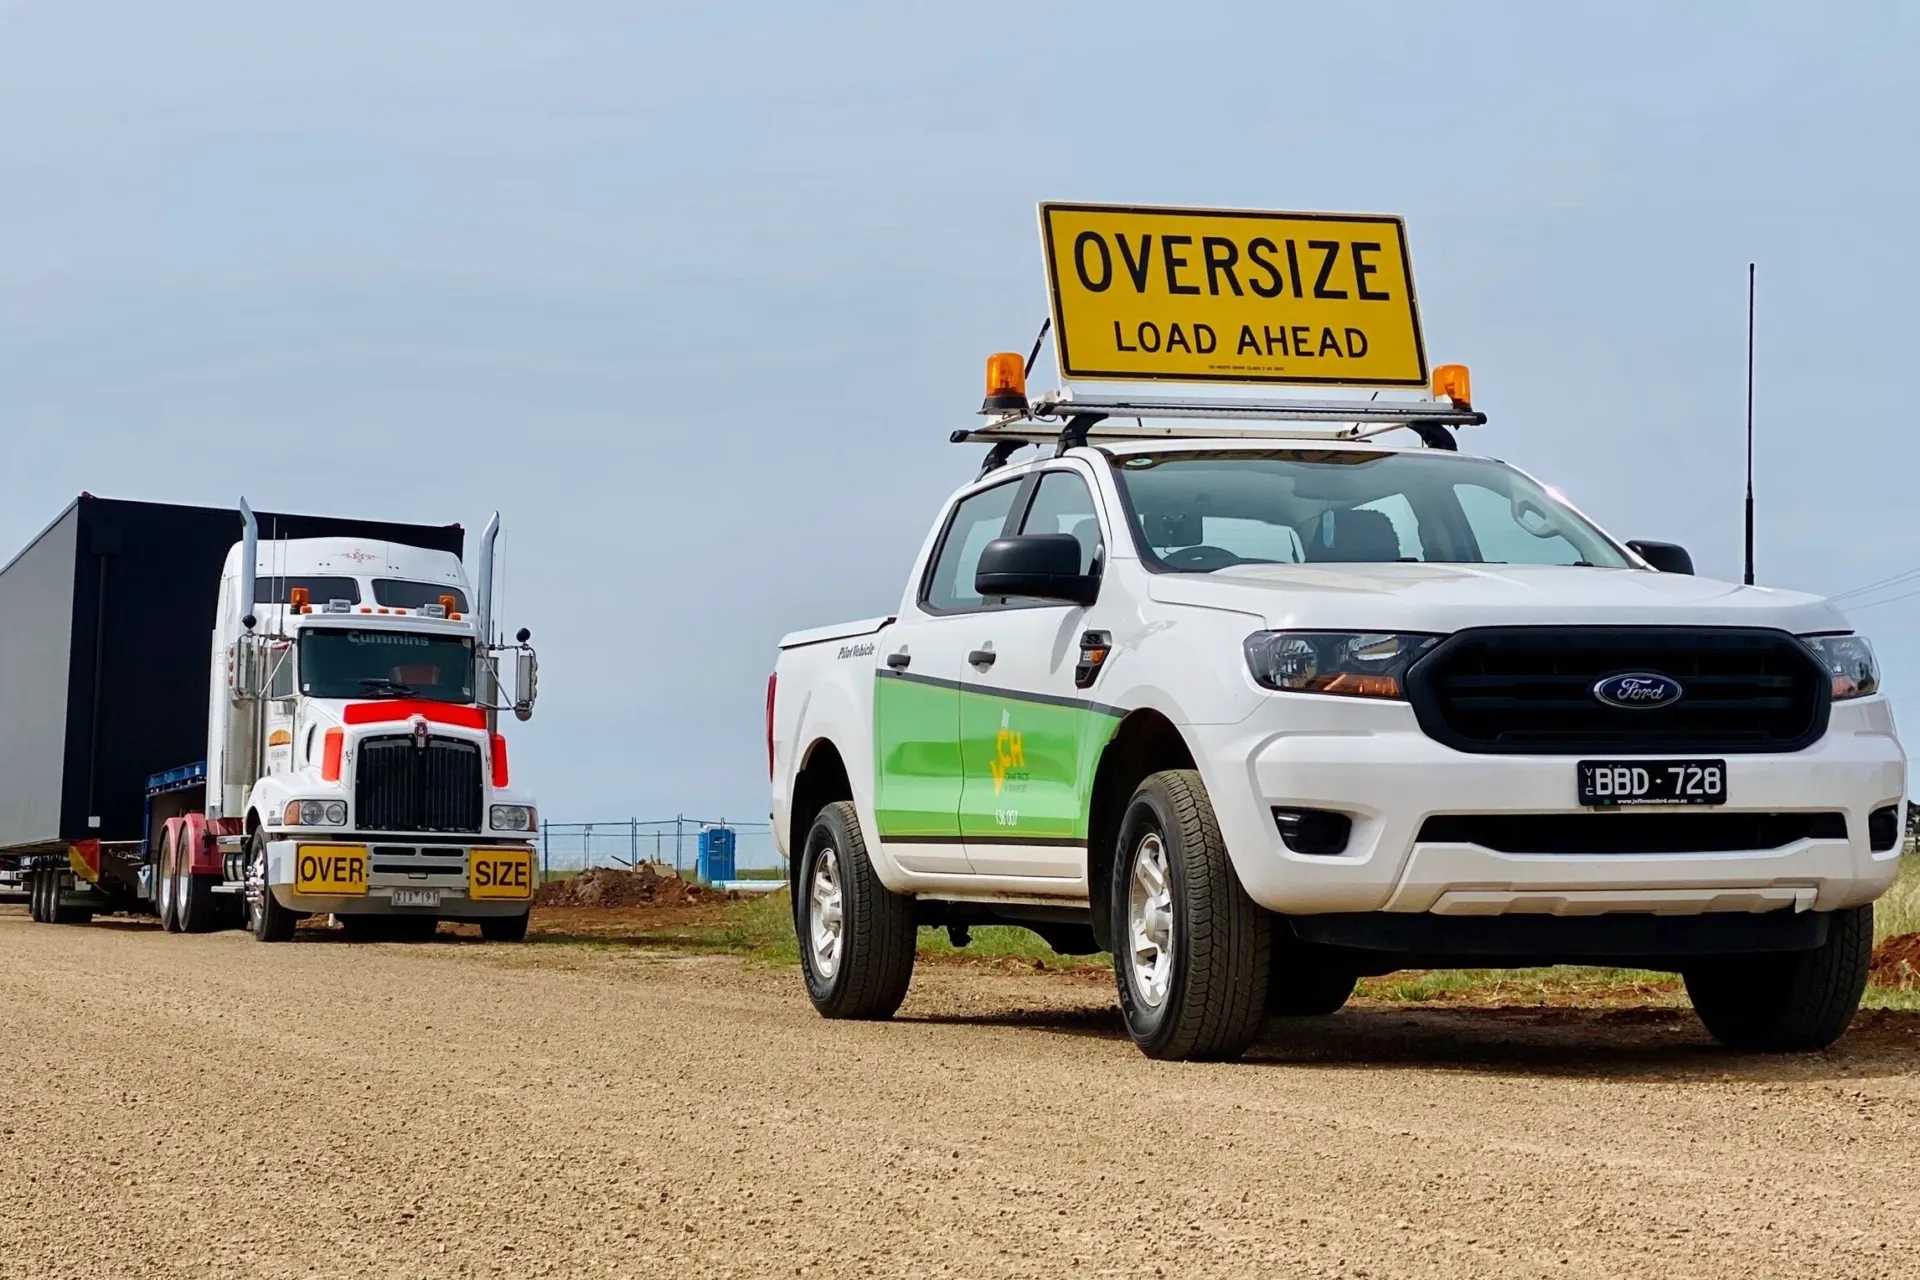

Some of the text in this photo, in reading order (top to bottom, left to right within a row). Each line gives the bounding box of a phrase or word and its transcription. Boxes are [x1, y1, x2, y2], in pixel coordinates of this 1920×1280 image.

[1073, 231, 1391, 301] OVERSIZE
[1113, 320, 1369, 358] LOAD AHEAD
[346, 630, 430, 647] Cummins
[837, 642, 875, 660] Pilot Vehicle
[1617, 678, 1665, 700] Ford
[1585, 768, 1595, 796] VIC
[300, 855, 364, 883] OVER
[475, 860, 528, 887] SIZE
